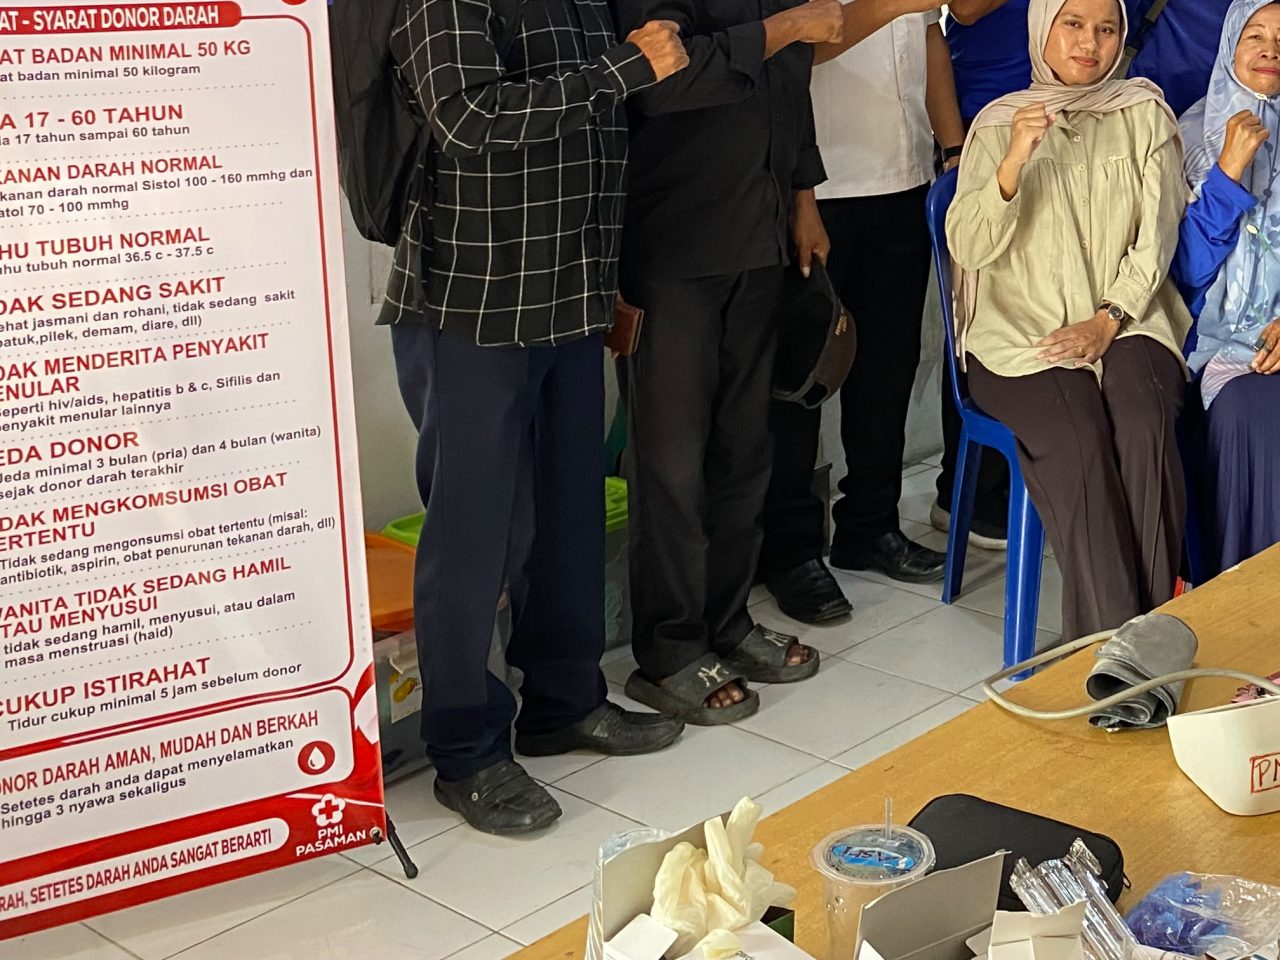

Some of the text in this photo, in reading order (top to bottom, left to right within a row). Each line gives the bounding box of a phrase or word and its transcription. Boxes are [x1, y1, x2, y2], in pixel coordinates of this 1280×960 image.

[33, 5, 219, 32] SYARAT DONOR DARAH
[32, 40, 251, 65] BADAN MINIMAL 50 KG
[103, 104, 184, 124] TAHUN
[67, 155, 223, 181] DARAH NORMAL
[36, 227, 211, 258] TUBUH NORMAL
[52, 276, 226, 311] SEDANG SAKIT
[44, 332, 270, 377] MENDERITA PENYAKIT
[52, 472, 288, 524] MENGKOMSUMSI OBAT
[83, 657, 211, 700] ISTIRAHAT
[8, 662, 302, 732] Tidur cukup minimal 5 jam sebelum donor
[42, 709, 319, 789] DARAH AMAN, MUDAH DAN BERKAH
[296, 829, 366, 856] PASAMAN
[317, 825, 343, 839] PMI
[30, 827, 272, 903] SETETES DARAH ANDA SANGAT BERARTI
